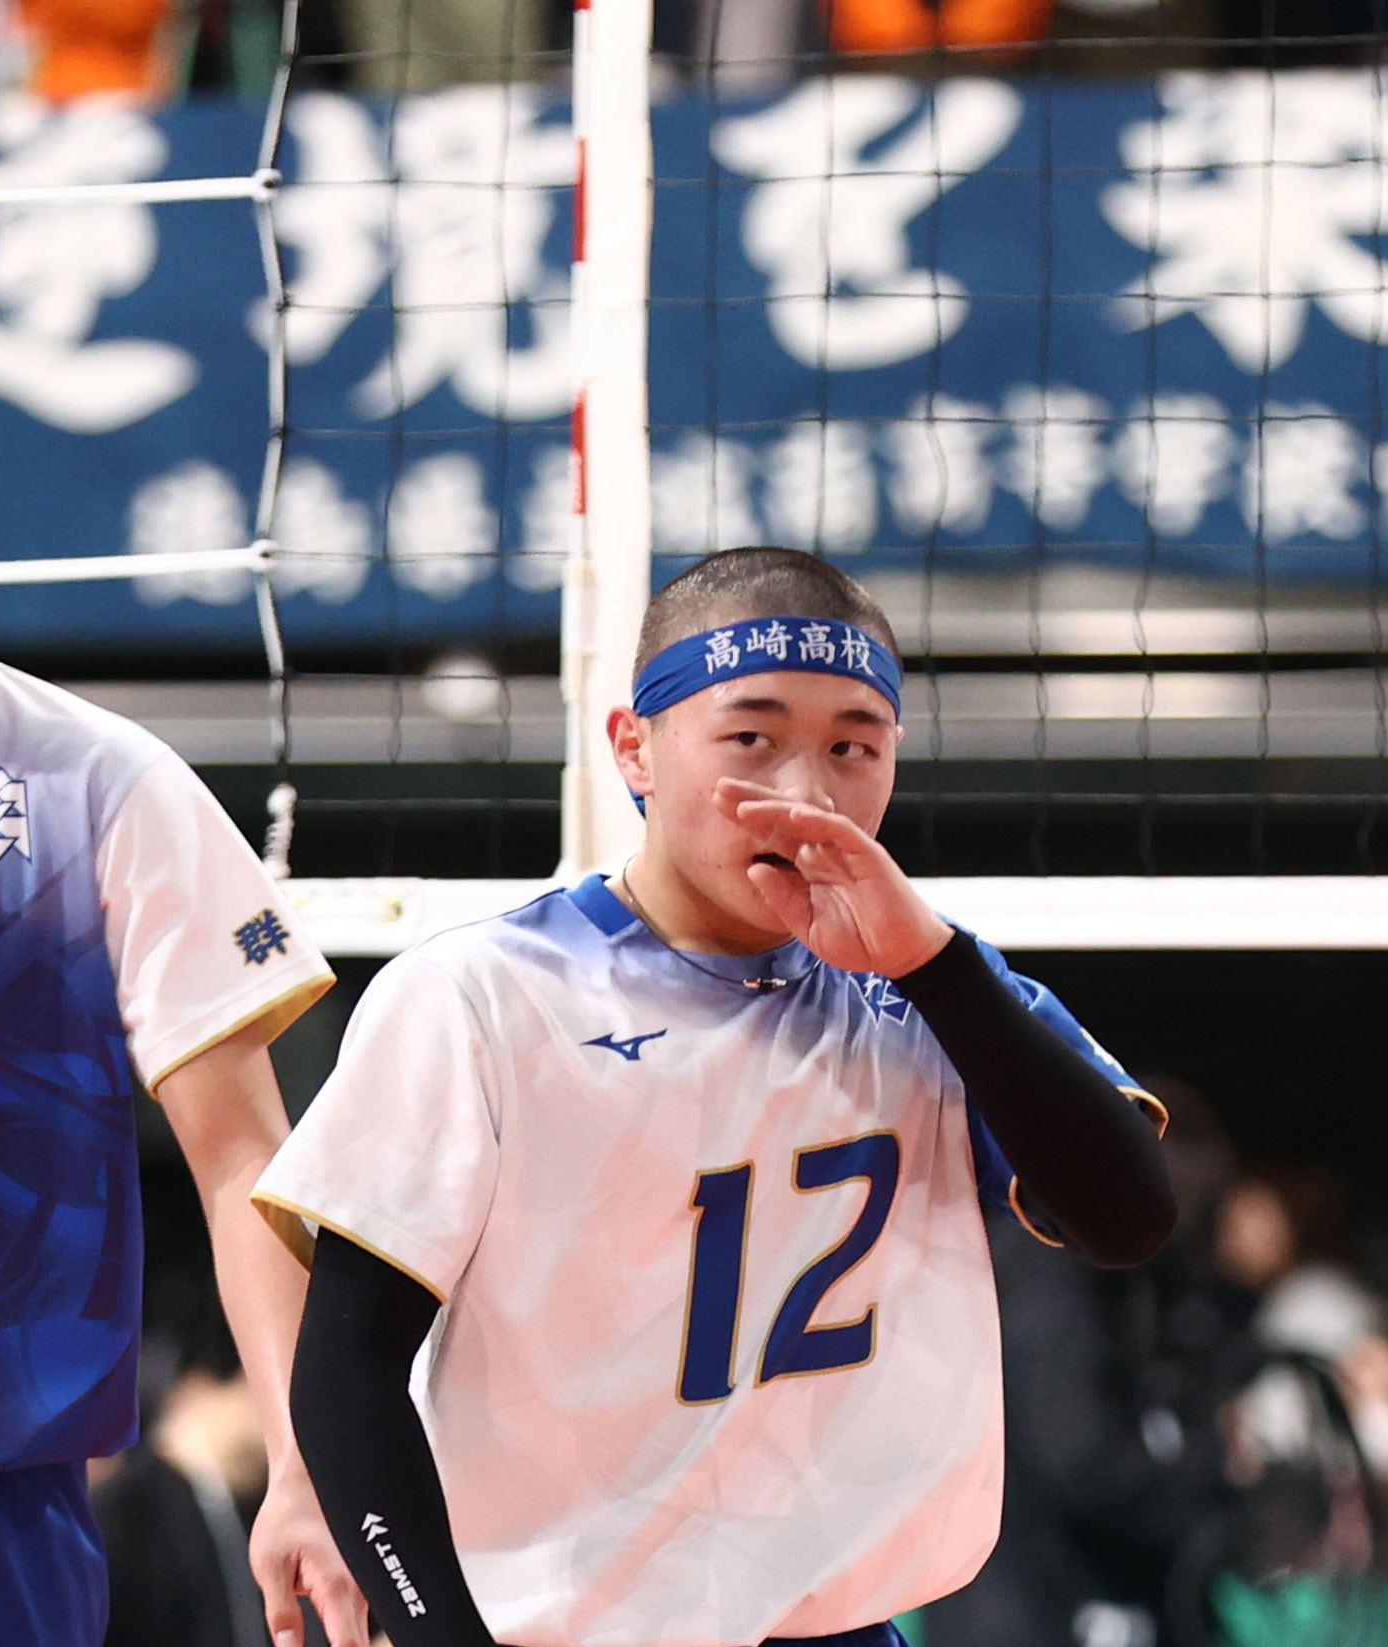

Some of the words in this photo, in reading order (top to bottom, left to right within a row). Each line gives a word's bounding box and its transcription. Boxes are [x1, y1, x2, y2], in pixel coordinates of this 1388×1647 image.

[704, 620, 876, 677] 高崎高校
[674, 1128, 901, 1407] 12
